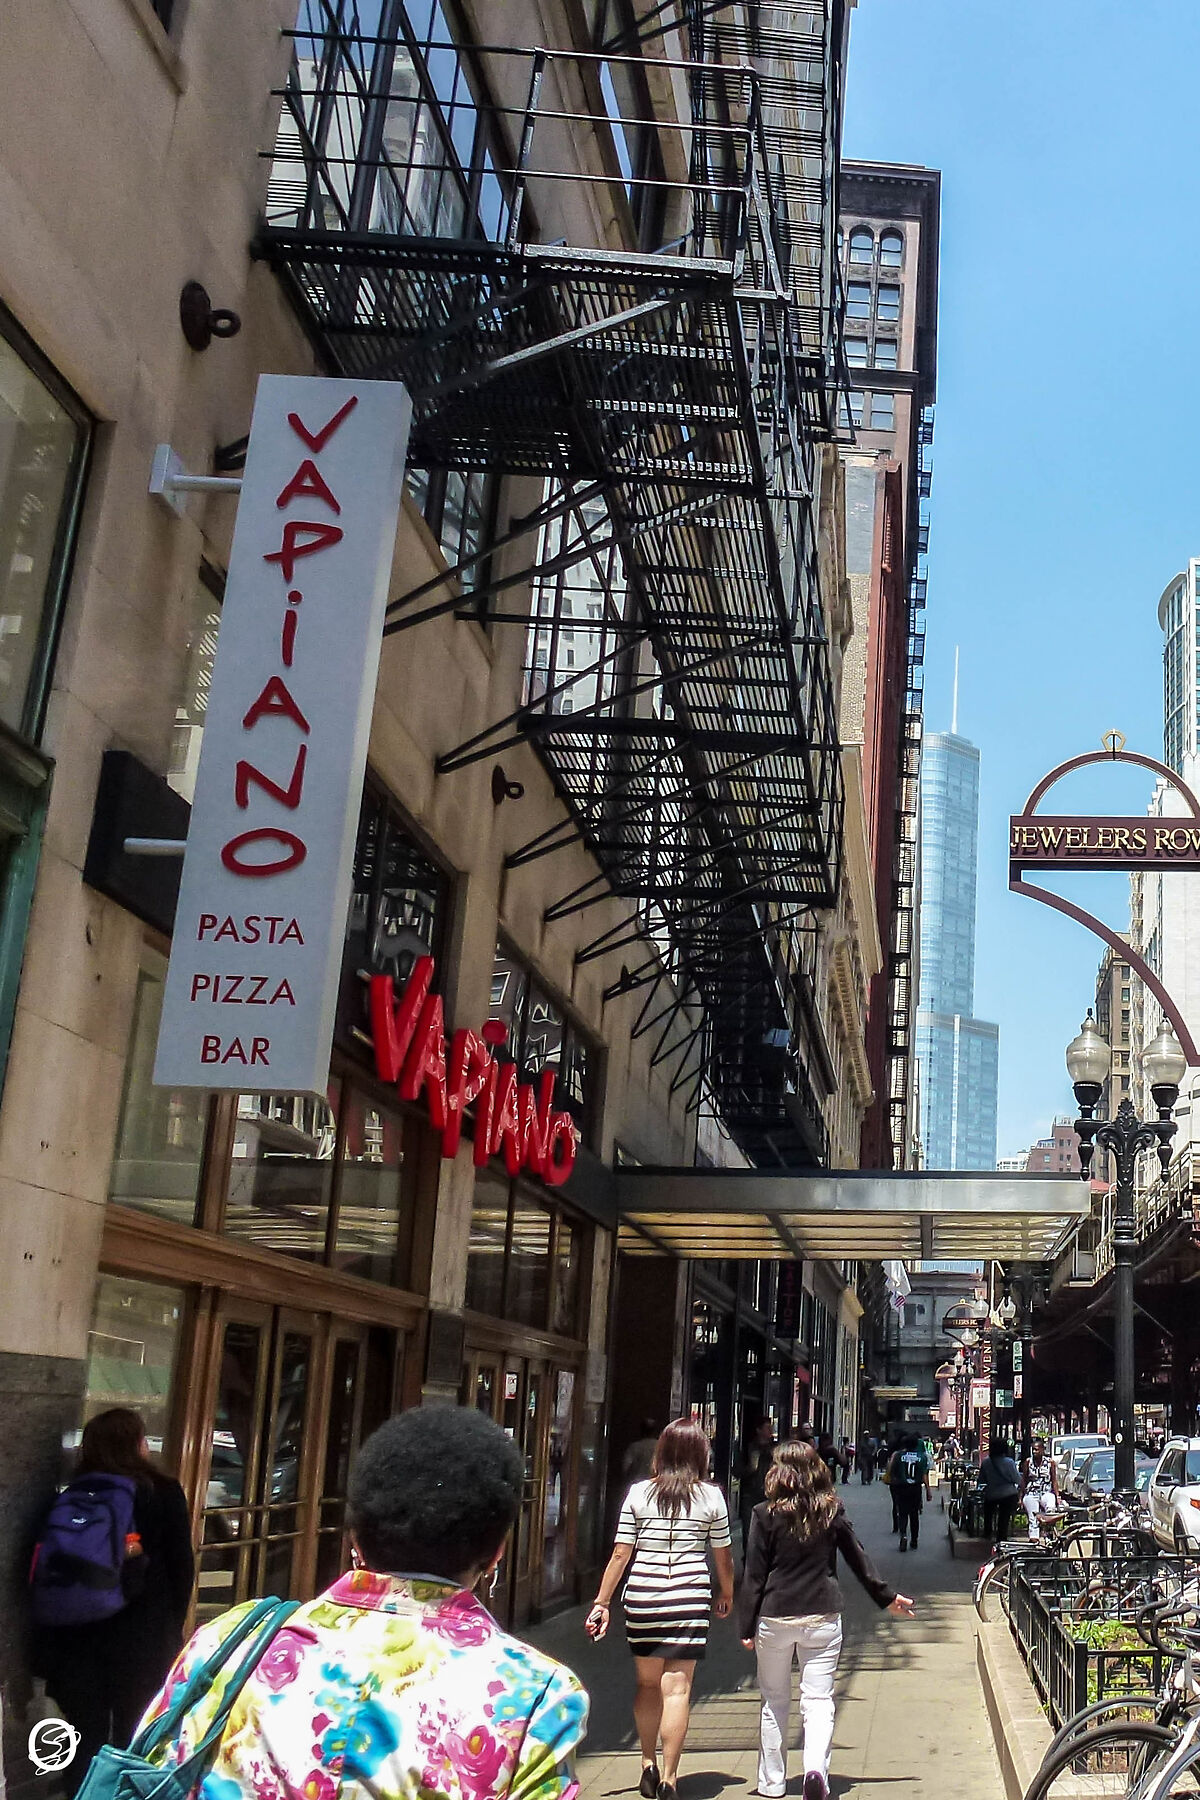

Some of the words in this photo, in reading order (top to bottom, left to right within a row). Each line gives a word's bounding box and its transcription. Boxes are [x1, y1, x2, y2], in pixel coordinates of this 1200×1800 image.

[1010, 825, 1147, 851] JEWELERS
[196, 914, 306, 946] PASTA
[190, 974, 297, 1006] PIZZA
[200, 1035, 272, 1067] BAR
